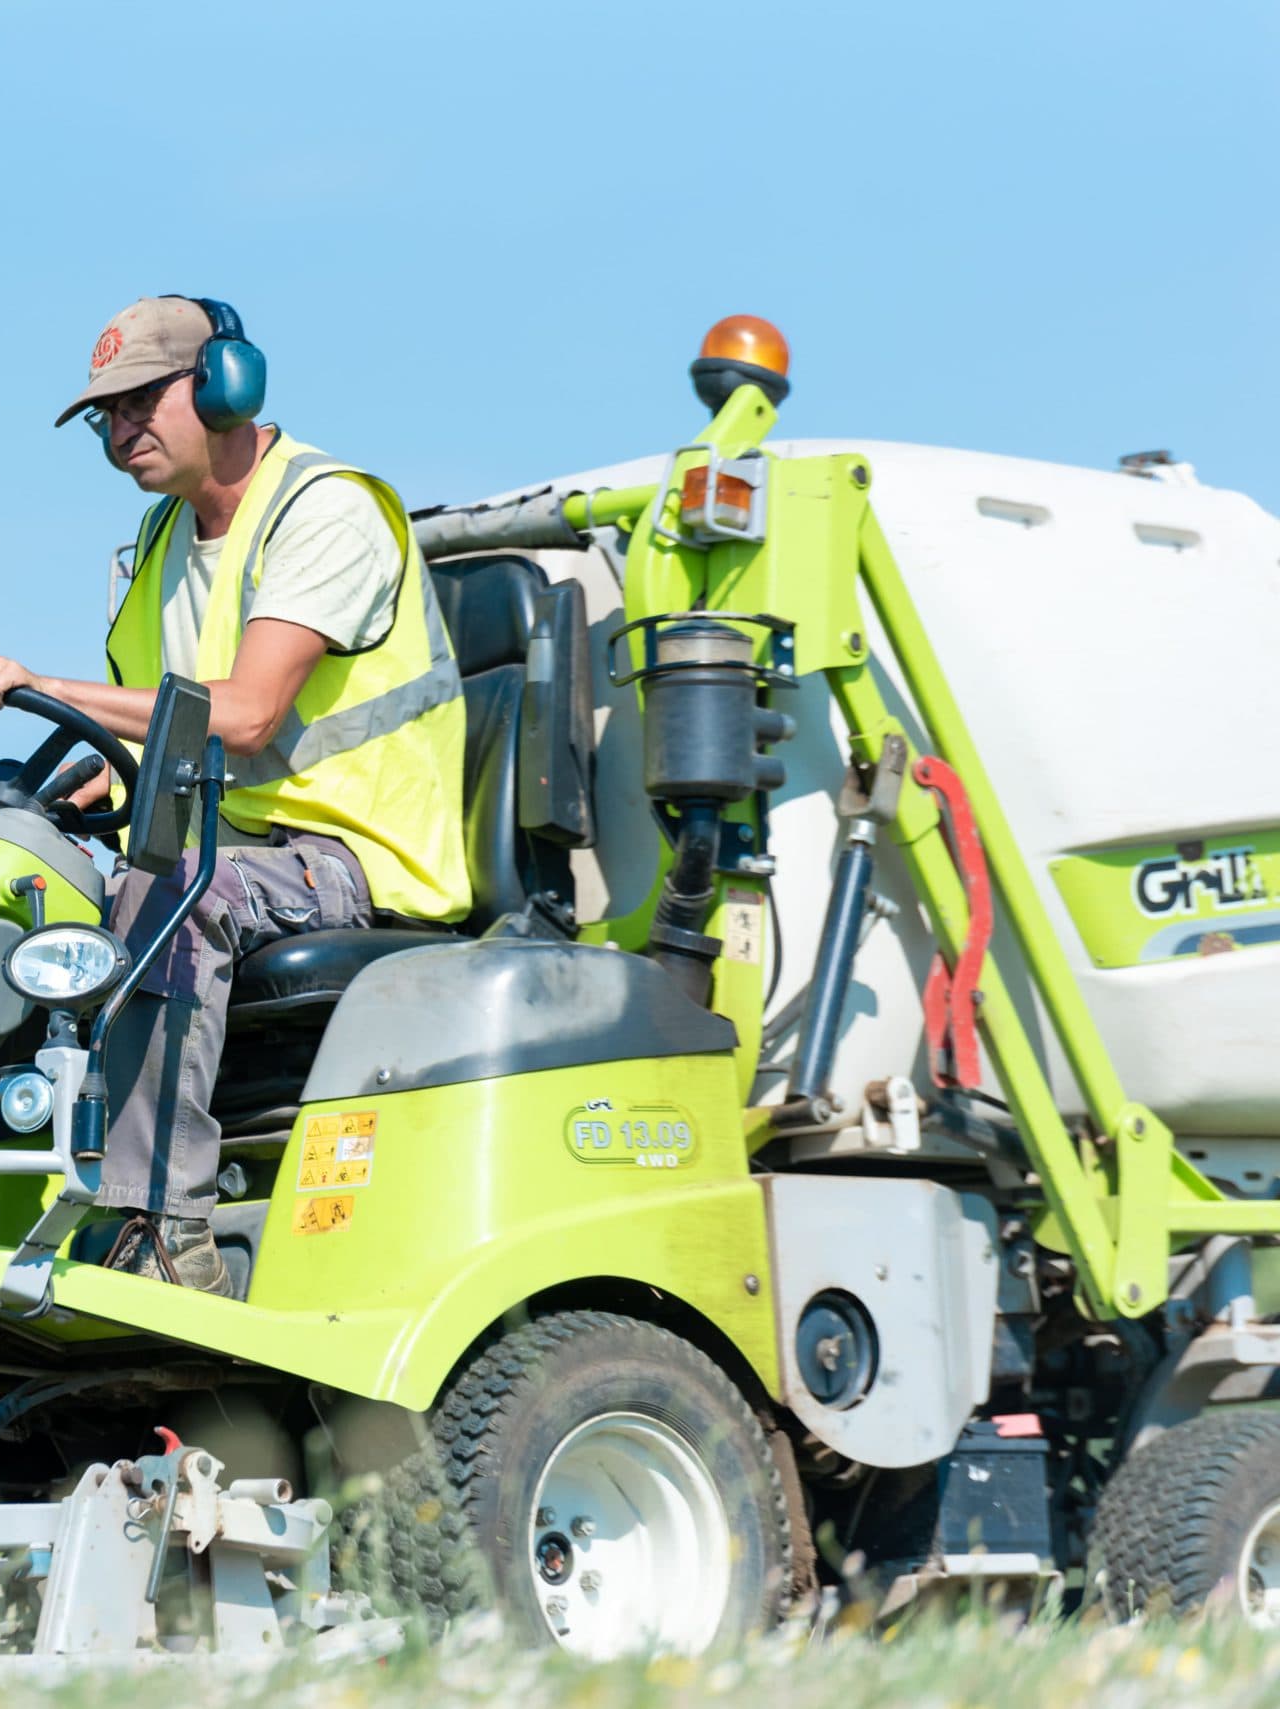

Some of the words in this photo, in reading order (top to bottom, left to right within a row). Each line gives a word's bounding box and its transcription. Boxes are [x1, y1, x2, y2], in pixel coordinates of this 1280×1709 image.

[574, 1120, 612, 1149] FD
[620, 1120, 692, 1150] 13.09
[636, 1153, 679, 1168] 4WD
